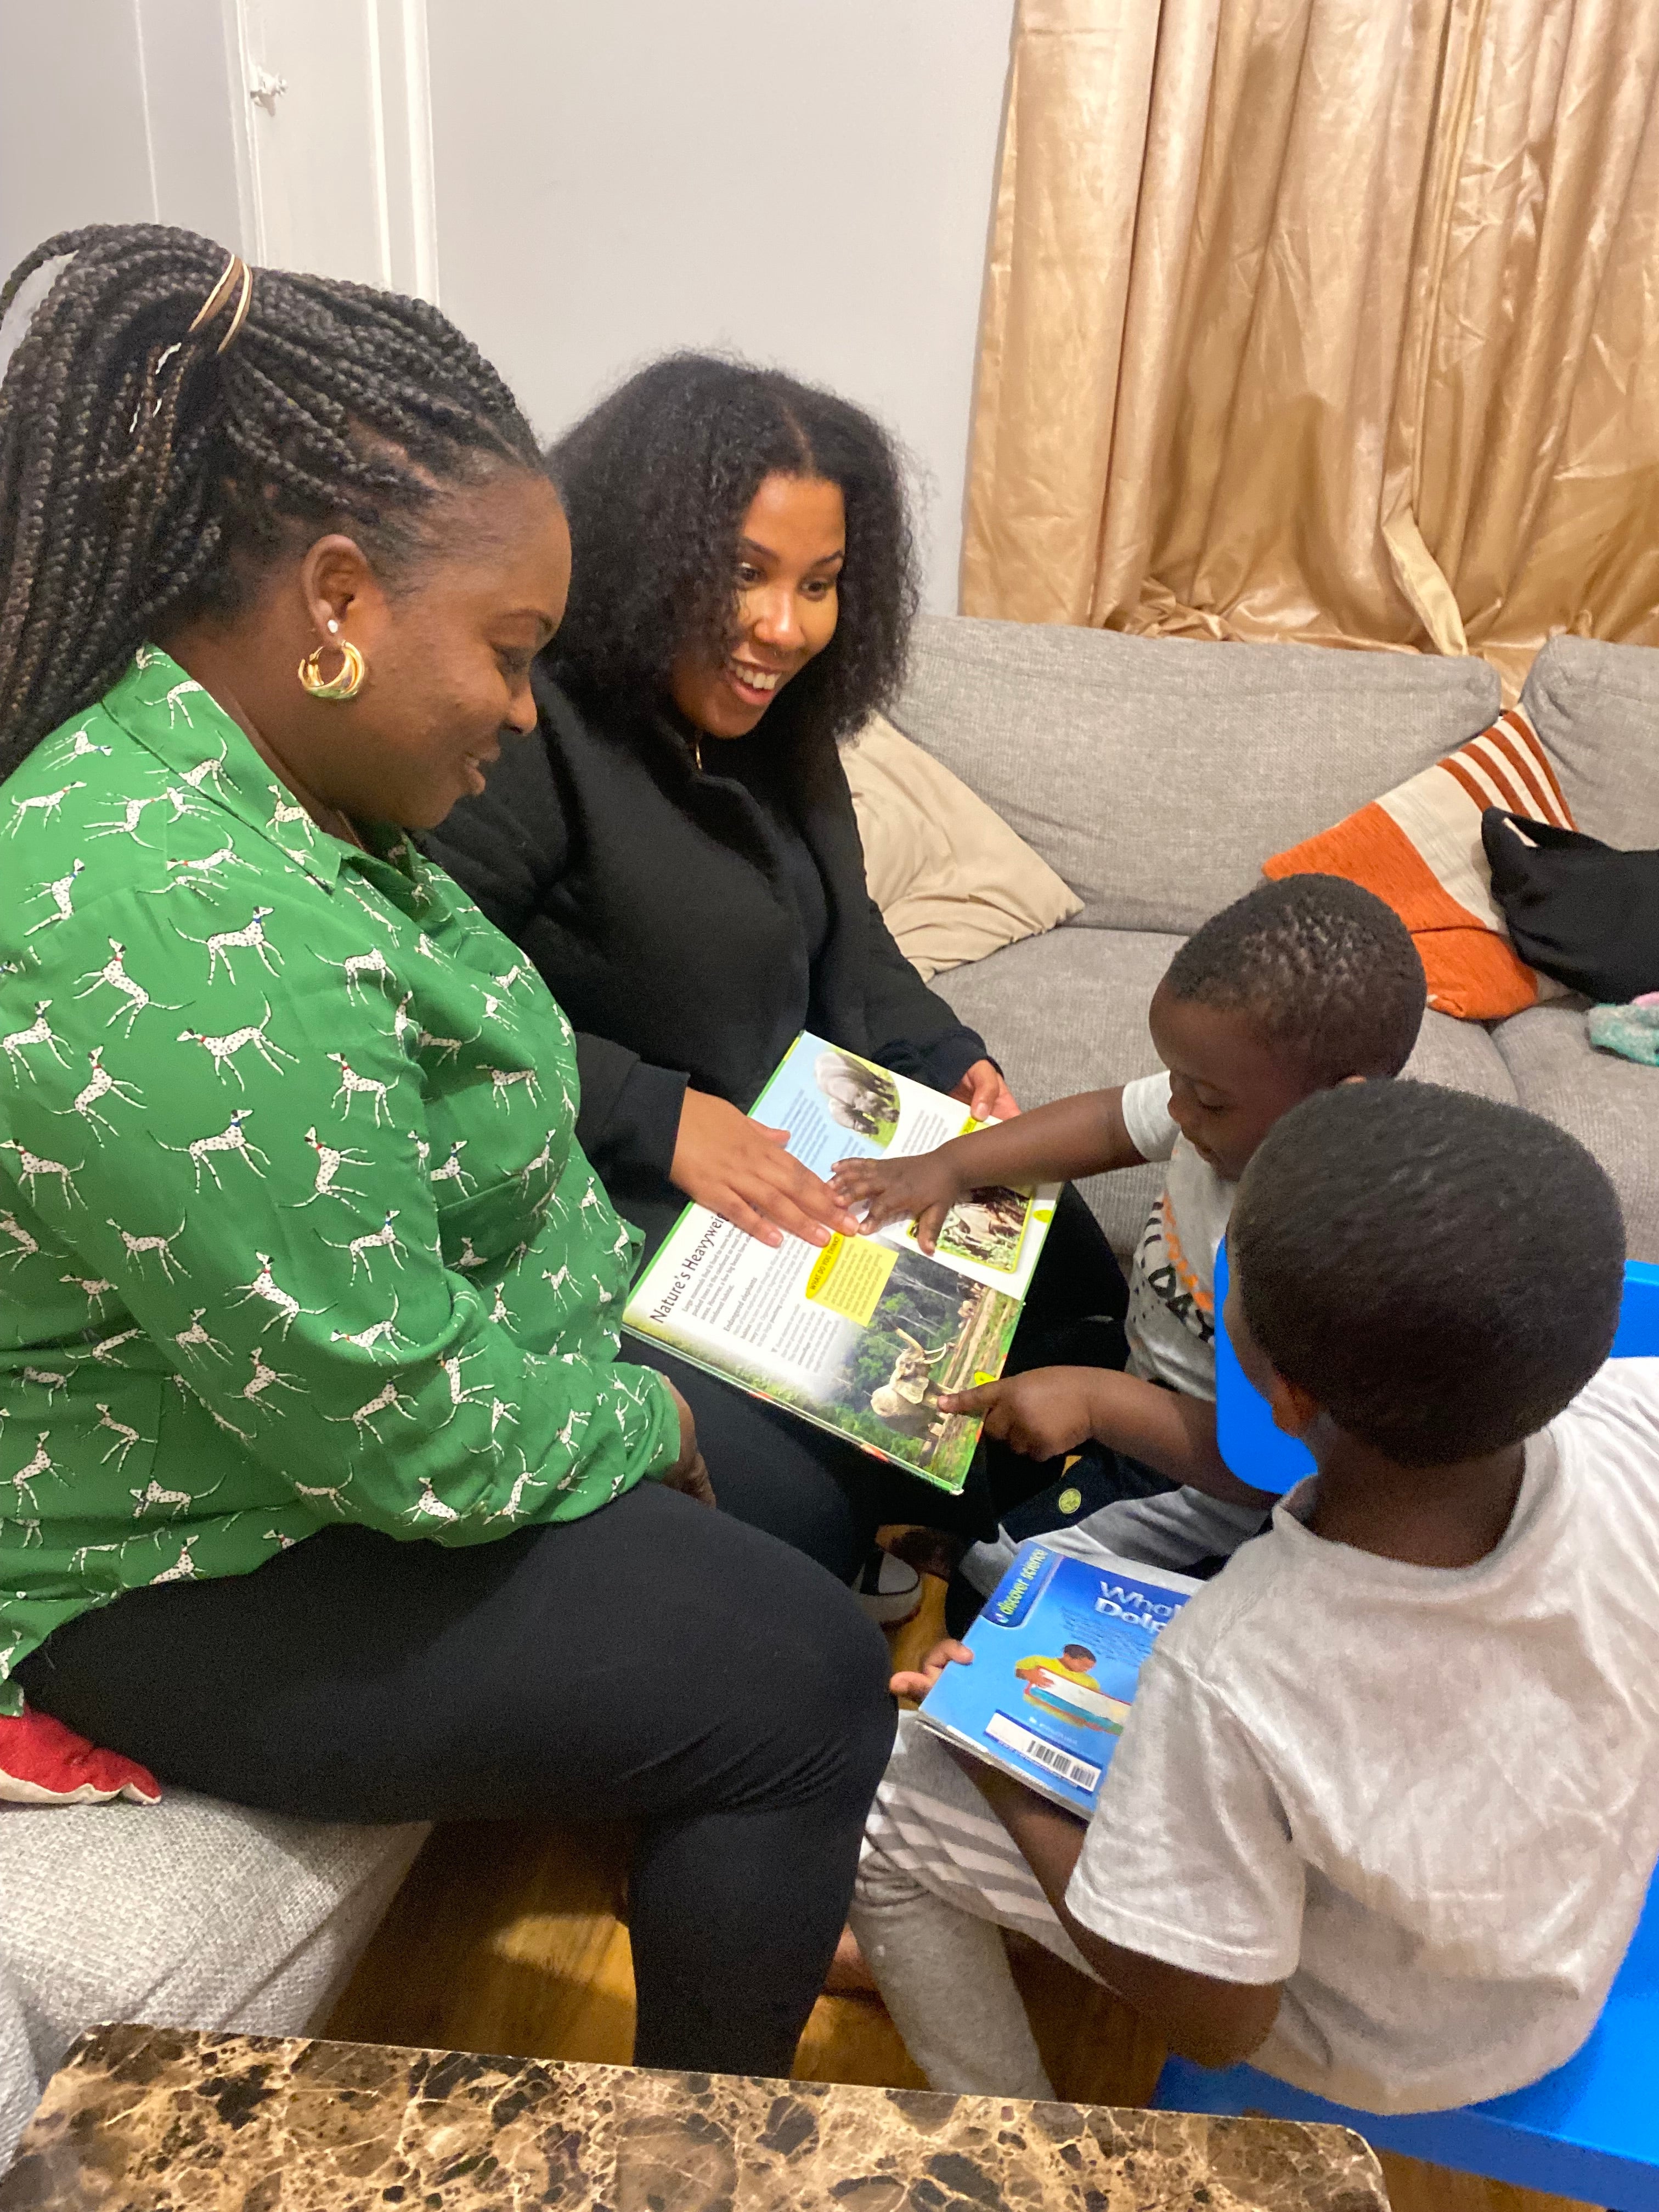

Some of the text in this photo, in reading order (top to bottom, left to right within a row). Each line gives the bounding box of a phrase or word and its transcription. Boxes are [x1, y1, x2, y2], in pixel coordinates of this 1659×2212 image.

[809, 1235, 841, 1290] WHAT DO YOU THINK?
[649, 1271, 691, 1324] Nature's
[723, 1276, 759, 1333] Endangered elephants
[996, 1549, 1048, 1616] discover science
